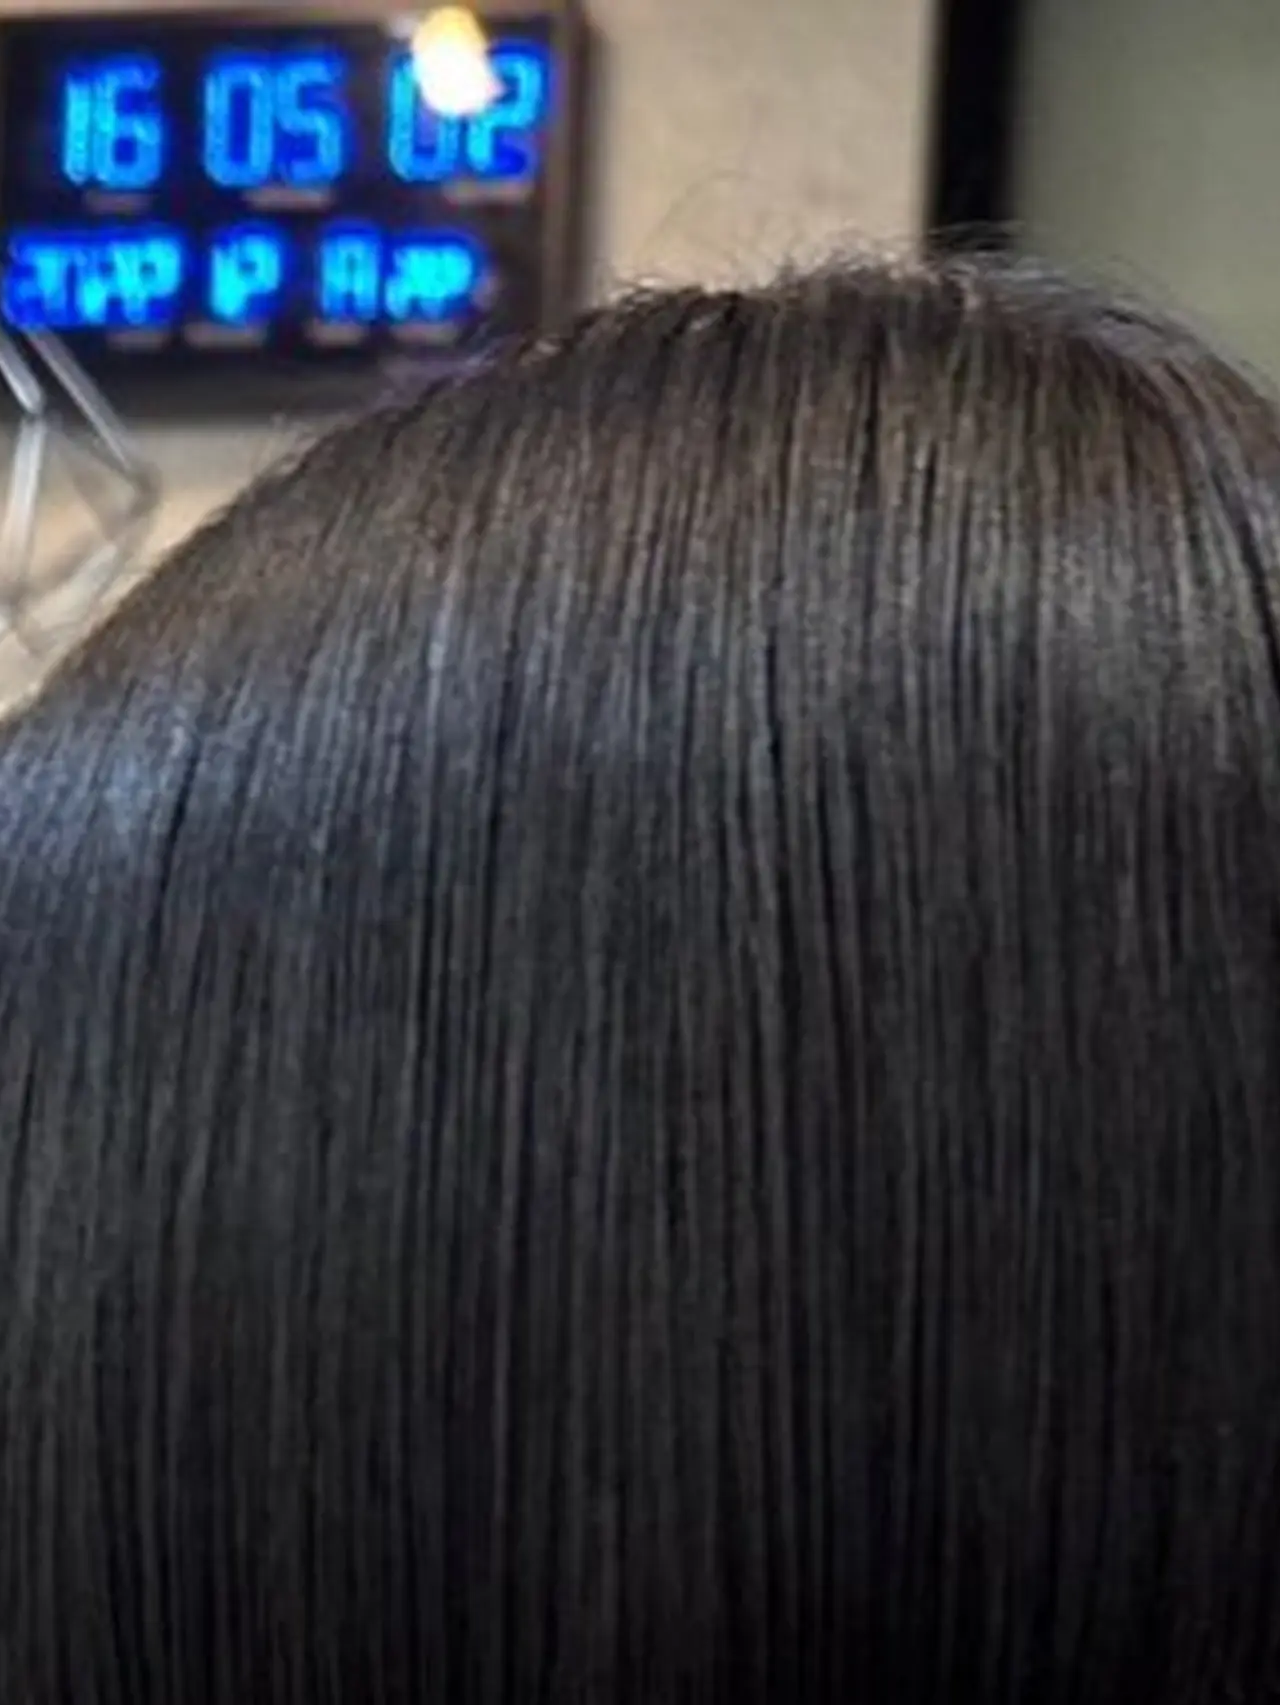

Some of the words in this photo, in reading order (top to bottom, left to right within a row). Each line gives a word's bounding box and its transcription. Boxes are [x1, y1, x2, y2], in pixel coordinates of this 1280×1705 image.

[60, 56, 164, 190] 16
[202, 52, 345, 190] 05
[384, 42, 554, 186] 02
